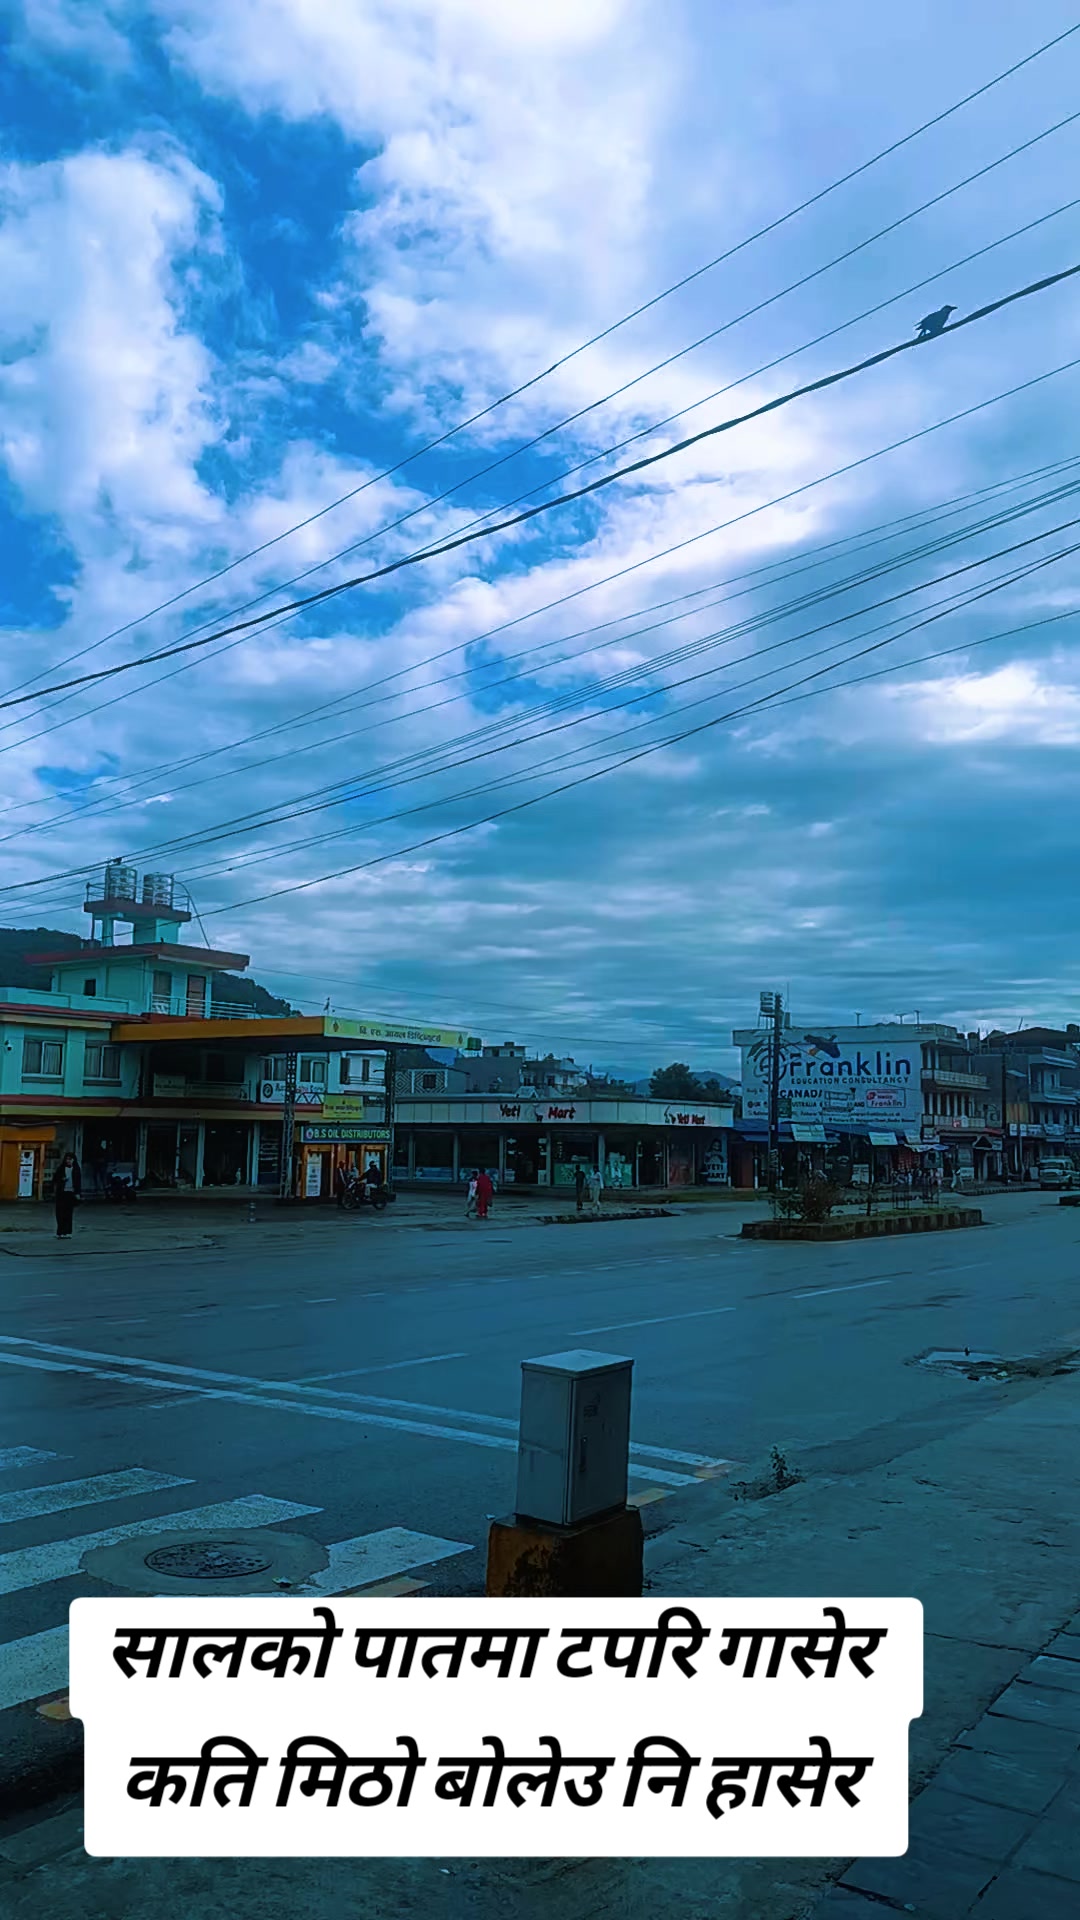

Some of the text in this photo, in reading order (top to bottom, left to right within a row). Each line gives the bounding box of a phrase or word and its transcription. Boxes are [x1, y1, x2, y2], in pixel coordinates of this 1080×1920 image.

[790, 1051, 911, 1076] Franklin
[791, 1076, 909, 1085] EDUCATION CONSULTANCY
[499, 1104, 575, 1120] Yeti Mart
[691, 1114, 706, 1125] Mart
[328, 1129, 339, 1139] OIL
[341, 1129, 391, 1139] DISTRIBUTORS
[707, 1163, 723, 1171] YETI
